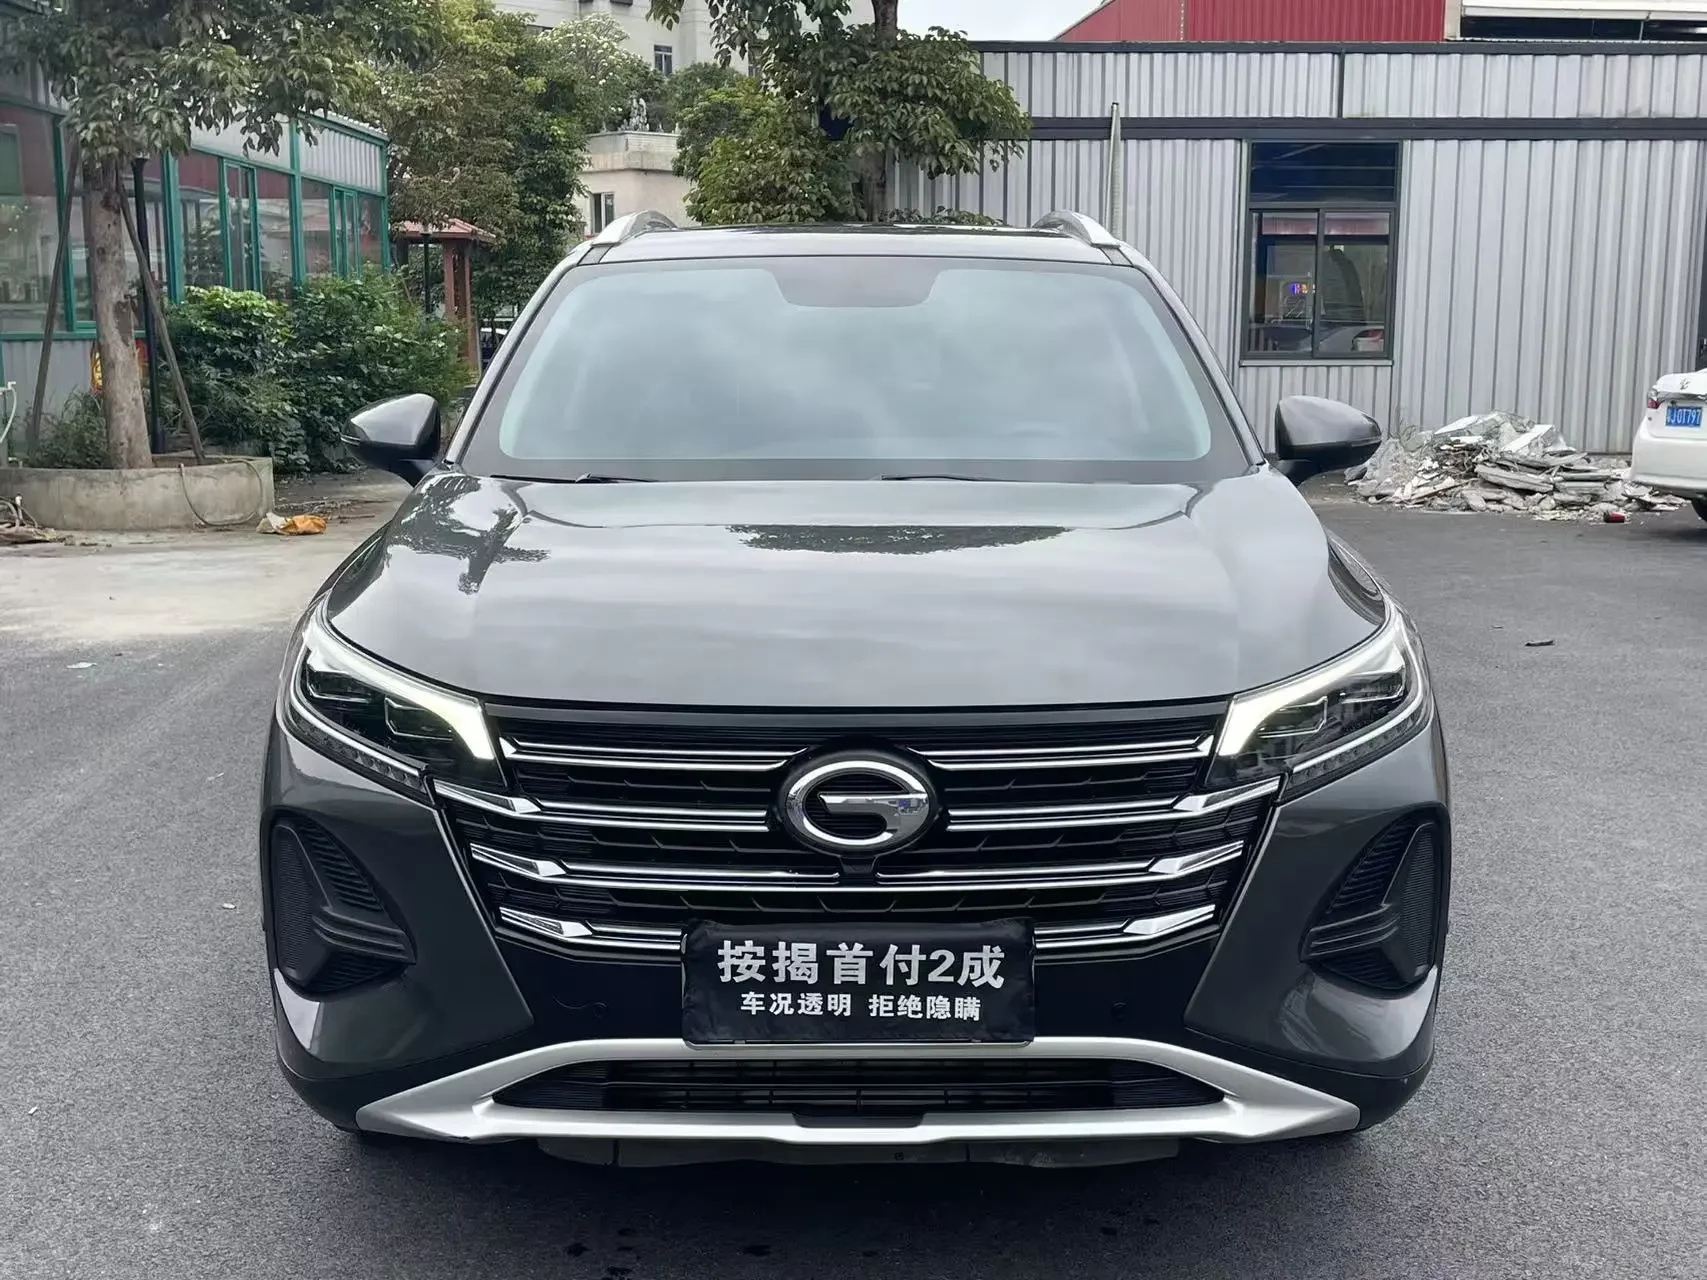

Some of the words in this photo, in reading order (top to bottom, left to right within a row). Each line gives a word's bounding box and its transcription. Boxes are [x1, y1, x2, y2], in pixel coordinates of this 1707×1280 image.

[717, 940, 1006, 989] 按揭首付2成
[740, 991, 851, 1017] 车况透明
[868, 994, 981, 1021] 拒绝隐瞒
